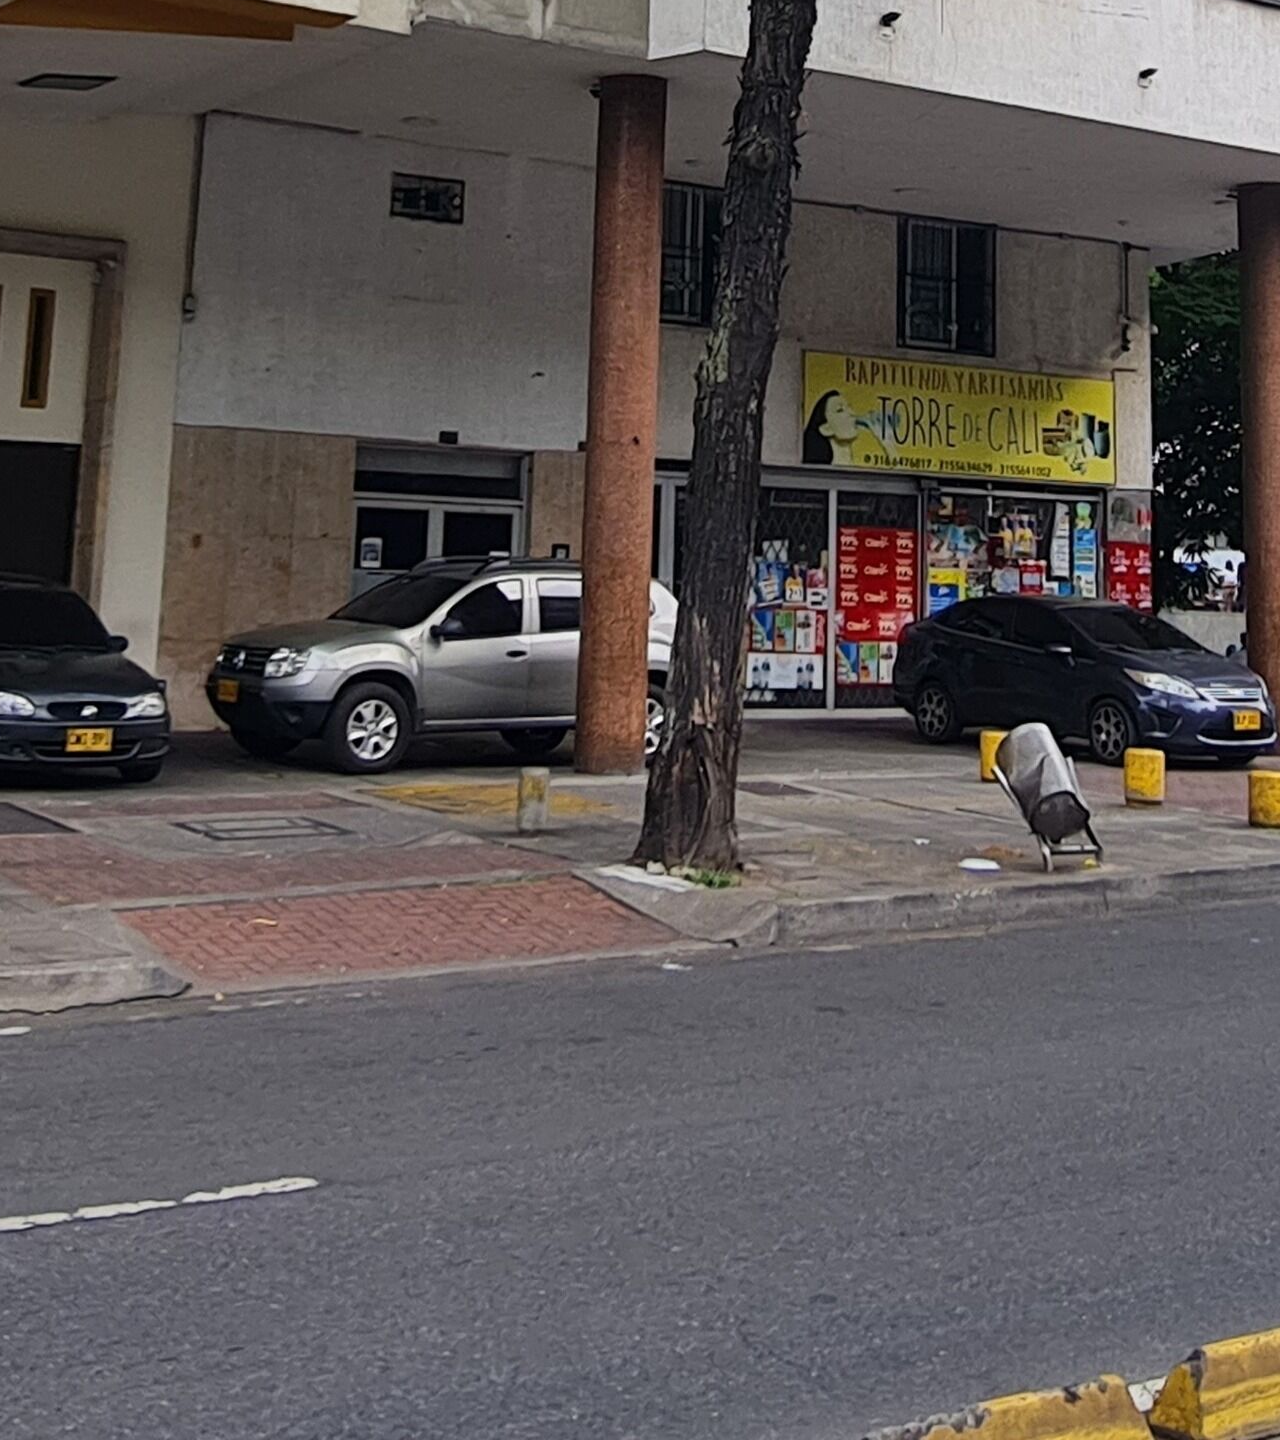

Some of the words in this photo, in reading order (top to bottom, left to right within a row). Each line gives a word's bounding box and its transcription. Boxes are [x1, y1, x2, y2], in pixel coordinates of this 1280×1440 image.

[954, 371, 964, 395] Y
[877, 396, 956, 448] TORRE
[963, 413, 982, 442] DE
[988, 407, 1039, 455] CALI
